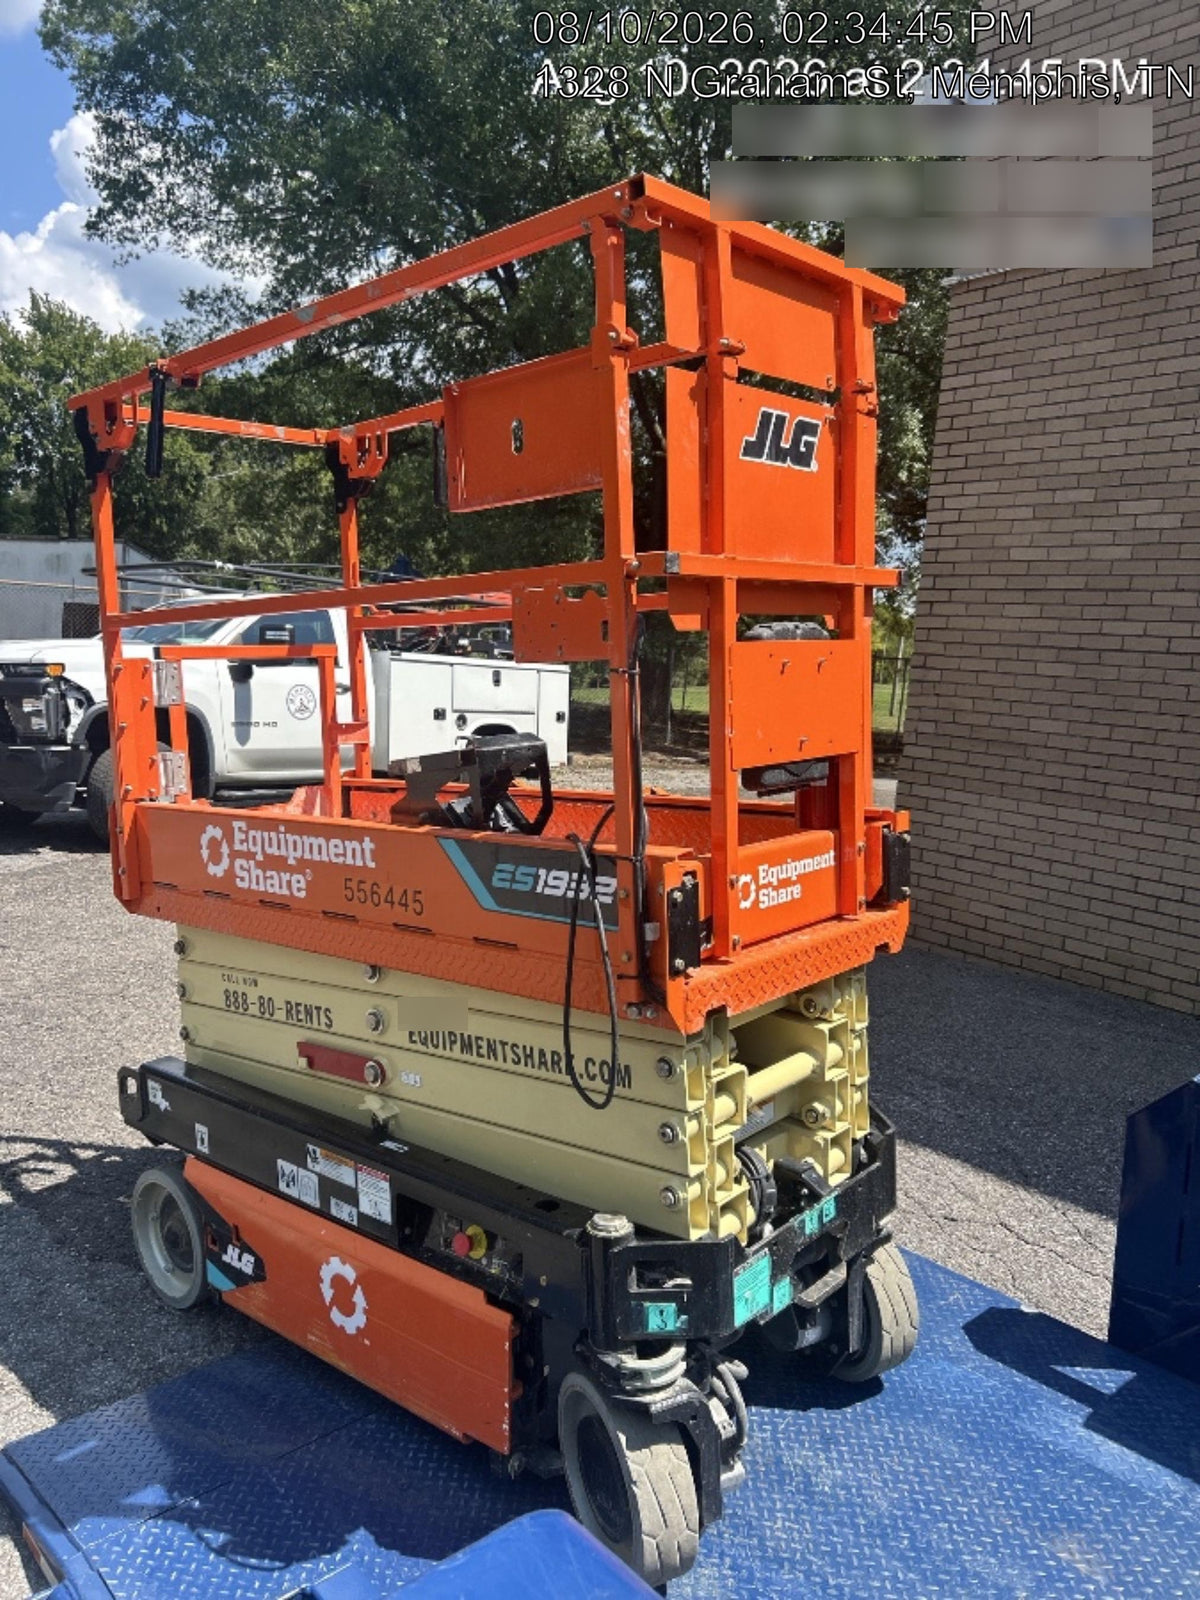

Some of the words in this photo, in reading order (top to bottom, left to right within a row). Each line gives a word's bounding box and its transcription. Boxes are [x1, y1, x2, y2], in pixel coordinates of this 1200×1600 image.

[739, 406, 822, 473] JLG
[232, 821, 376, 869] Equipment
[491, 863, 618, 904] ES1932
[758, 849, 836, 886] Equipment
[344, 877, 425, 917] 556445
[758, 883, 802, 909] Share
[224, 988, 334, 1030] 888-80-RENTS
[221, 1244, 256, 1276] JLG
